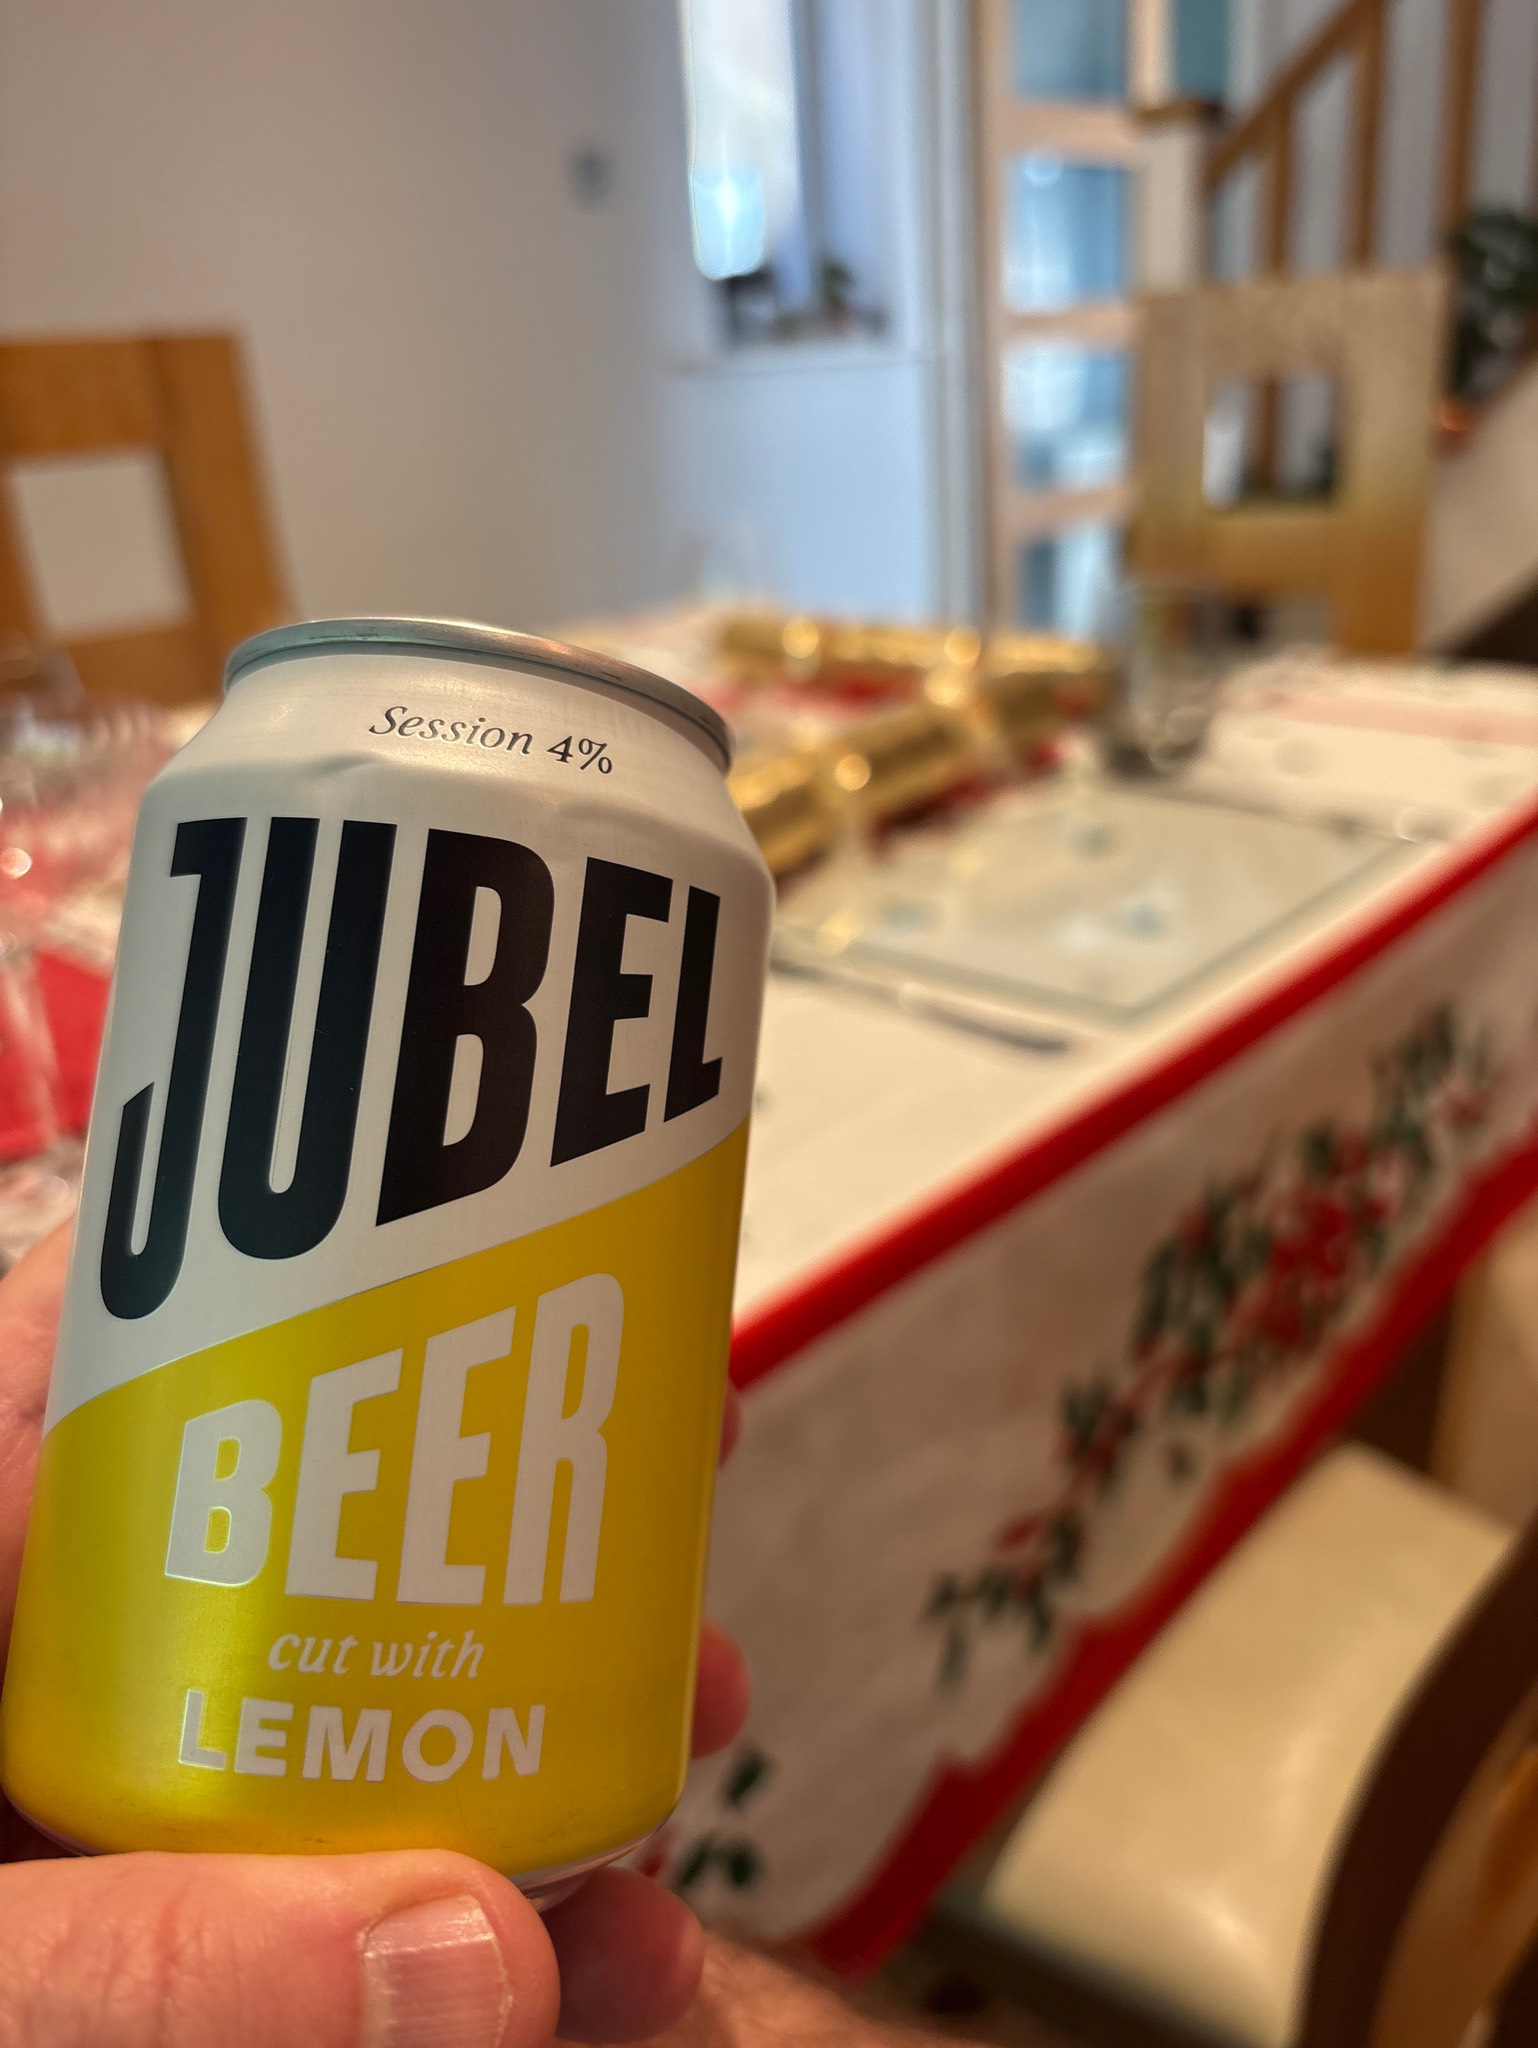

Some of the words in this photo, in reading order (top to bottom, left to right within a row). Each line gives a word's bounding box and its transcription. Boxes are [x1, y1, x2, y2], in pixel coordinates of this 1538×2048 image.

[367, 705, 534, 755] Session
[546, 735, 613, 775] 4%
[101, 816, 723, 1320] JUBEL
[163, 1272, 625, 1605] BEER
[268, 1630, 357, 1675] cut
[369, 1629, 485, 1679] with
[178, 1687, 546, 1782] LEMON
